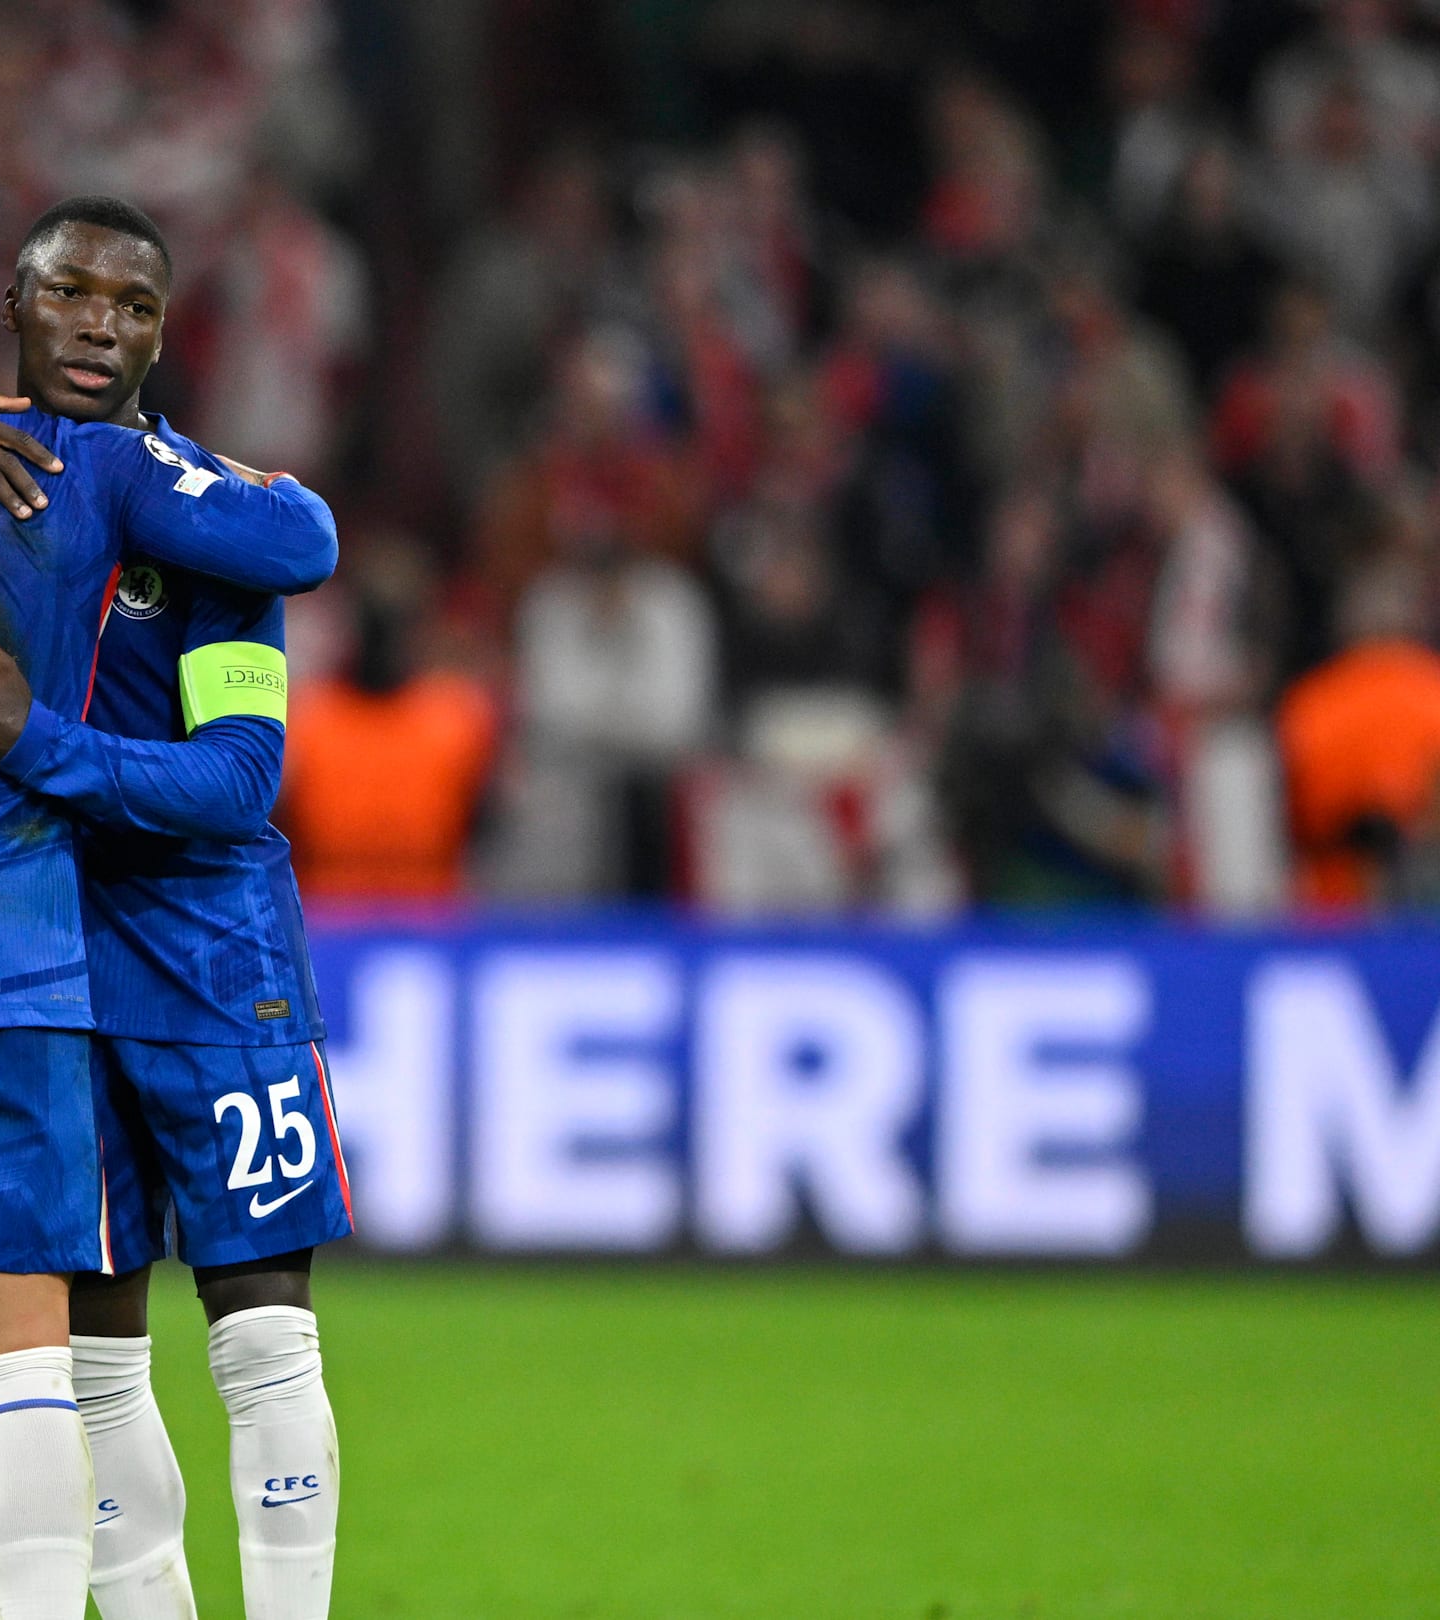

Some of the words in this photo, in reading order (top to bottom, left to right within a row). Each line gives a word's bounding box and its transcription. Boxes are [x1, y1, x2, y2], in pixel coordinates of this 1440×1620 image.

[223, 670, 285, 693] RESPECT
[213, 1074, 316, 1190] 25
[264, 1474, 319, 1492] CFC
